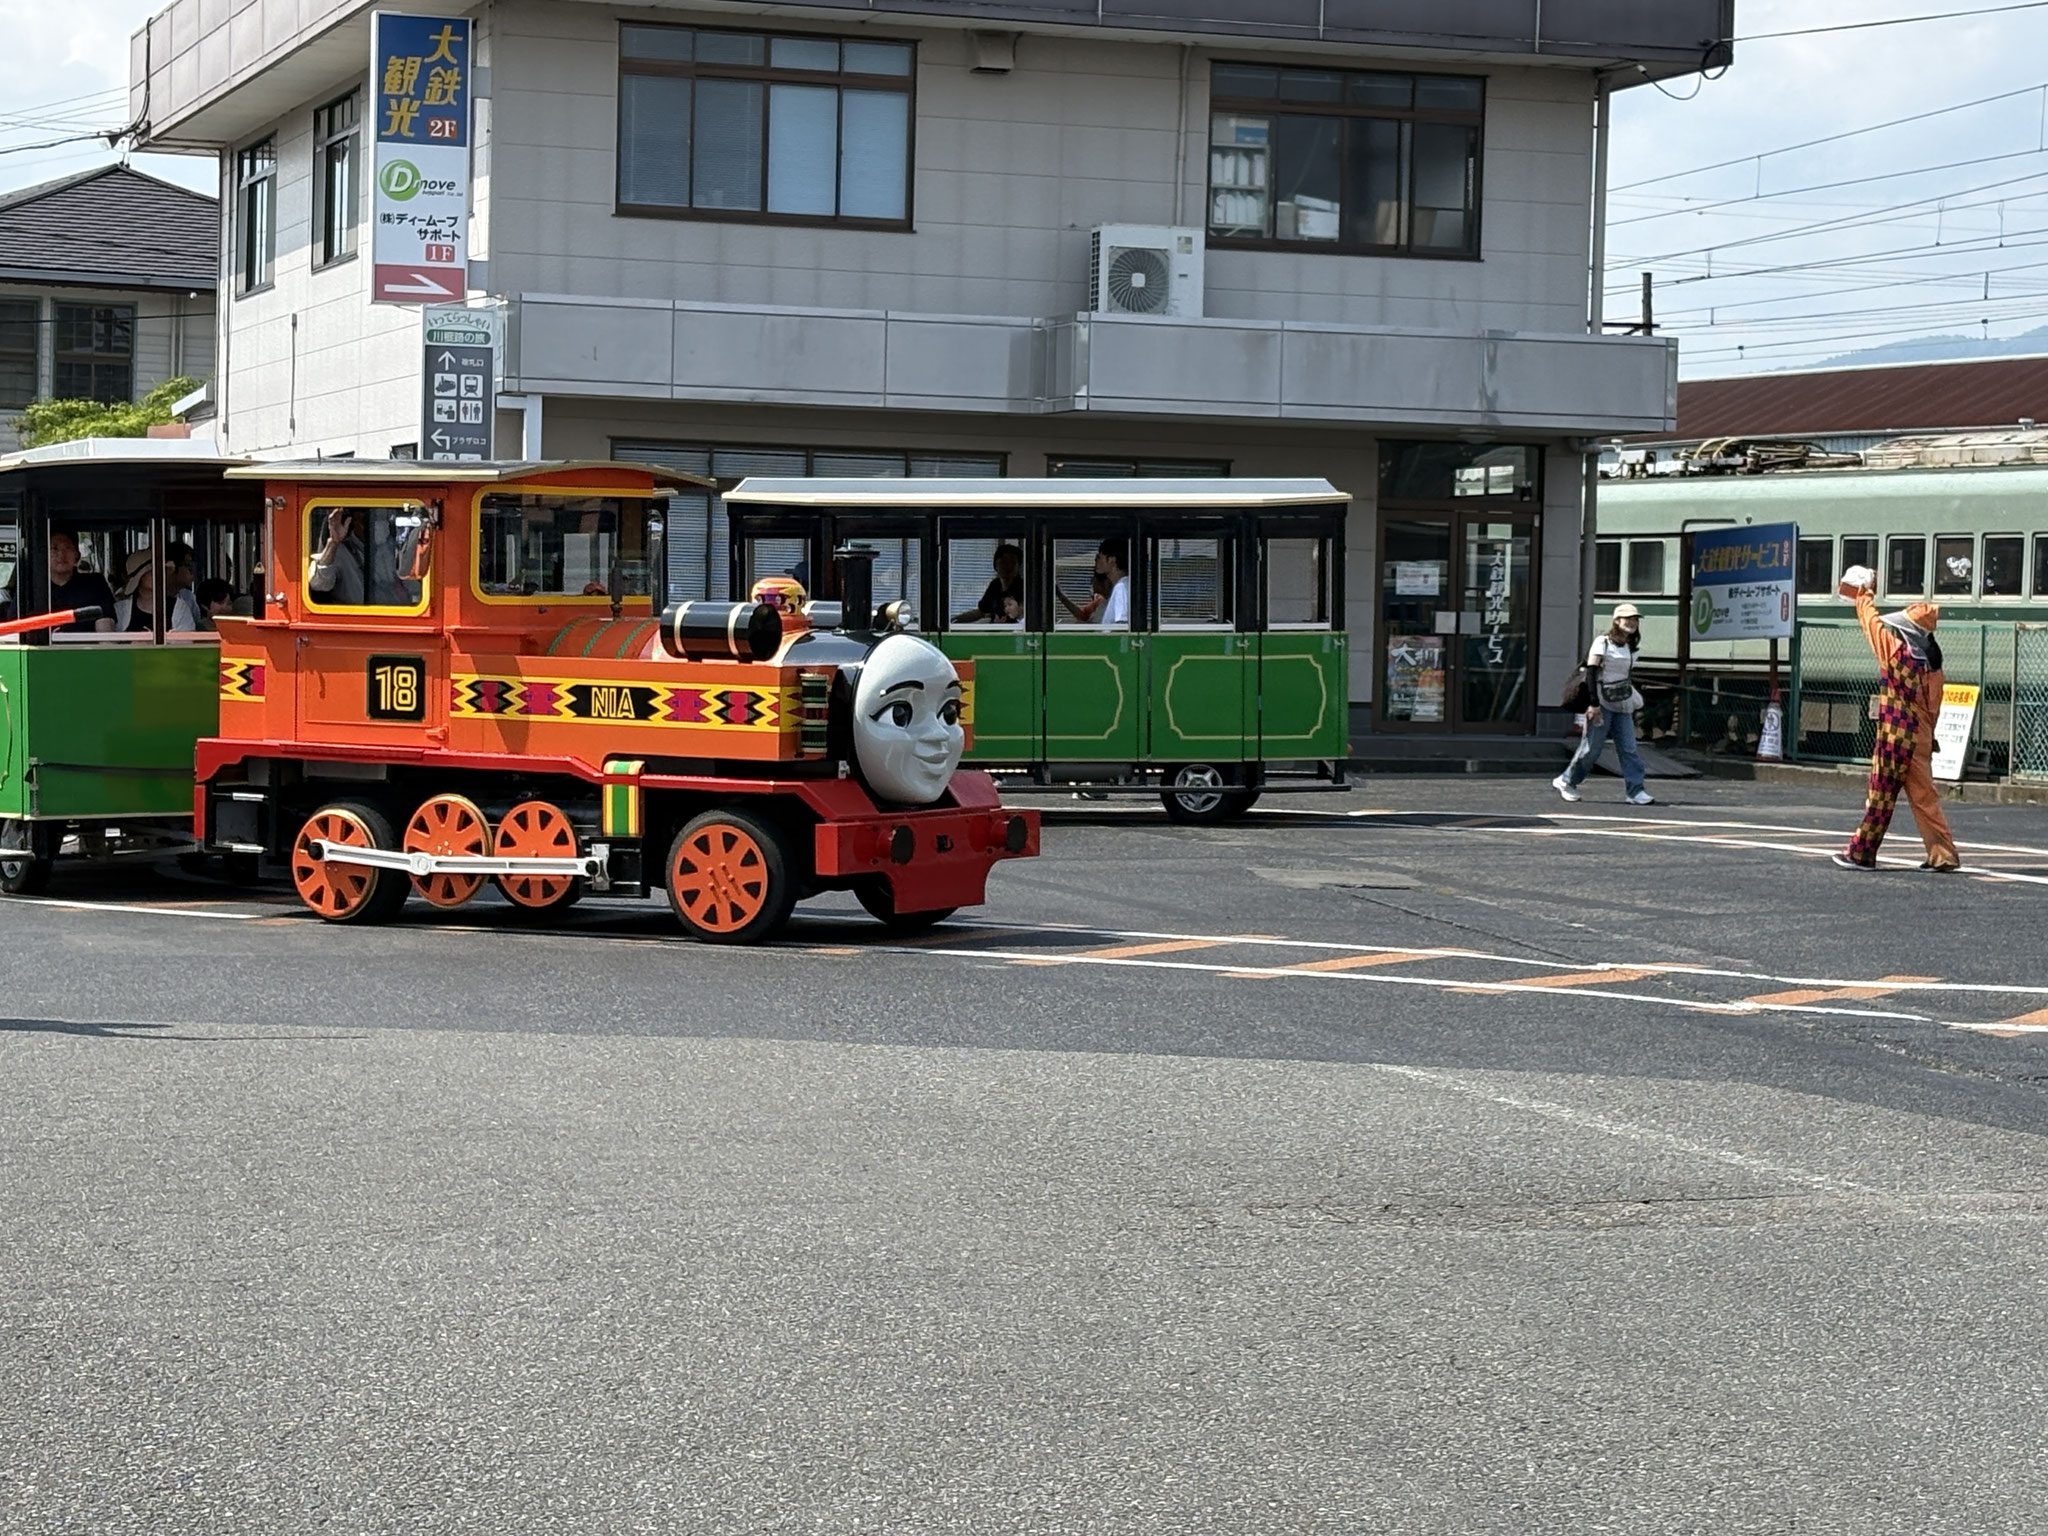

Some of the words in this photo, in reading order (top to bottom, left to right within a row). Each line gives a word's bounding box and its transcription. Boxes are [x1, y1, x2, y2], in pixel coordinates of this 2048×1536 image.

[424, 24, 463, 106] 大鉄
[381, 55, 422, 137] 観光
[430, 119, 457, 138] 2F
[417, 228, 461, 242] サポート
[429, 246, 453, 260] 1F
[375, 665, 417, 711] 18
[591, 686, 636, 719] NIA
